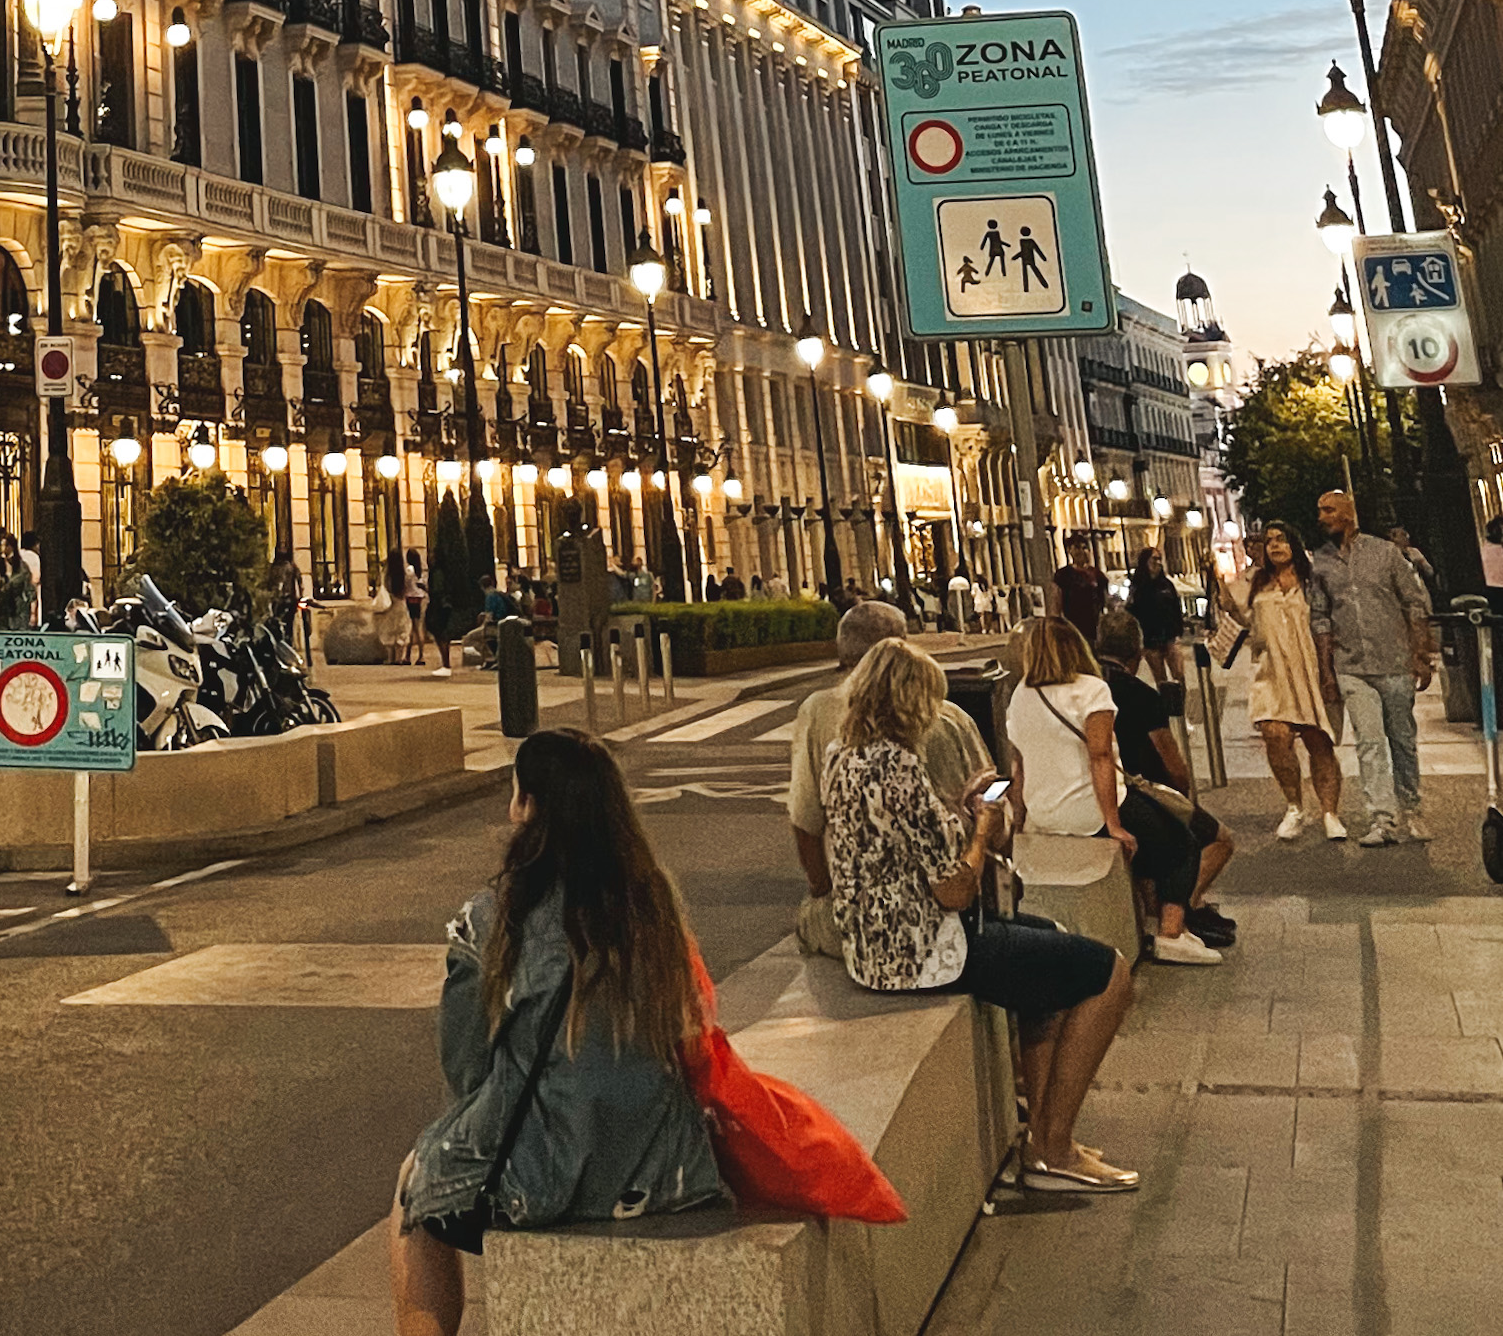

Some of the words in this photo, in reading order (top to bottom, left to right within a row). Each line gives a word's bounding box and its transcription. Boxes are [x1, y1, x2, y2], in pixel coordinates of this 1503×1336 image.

[887, 37, 925, 49] MADRID
[955, 39, 1067, 66] ZONA
[957, 65, 1069, 84] PEATONAL
[1408, 336, 1440, 359] 10
[4, 637, 46, 647] ZONA
